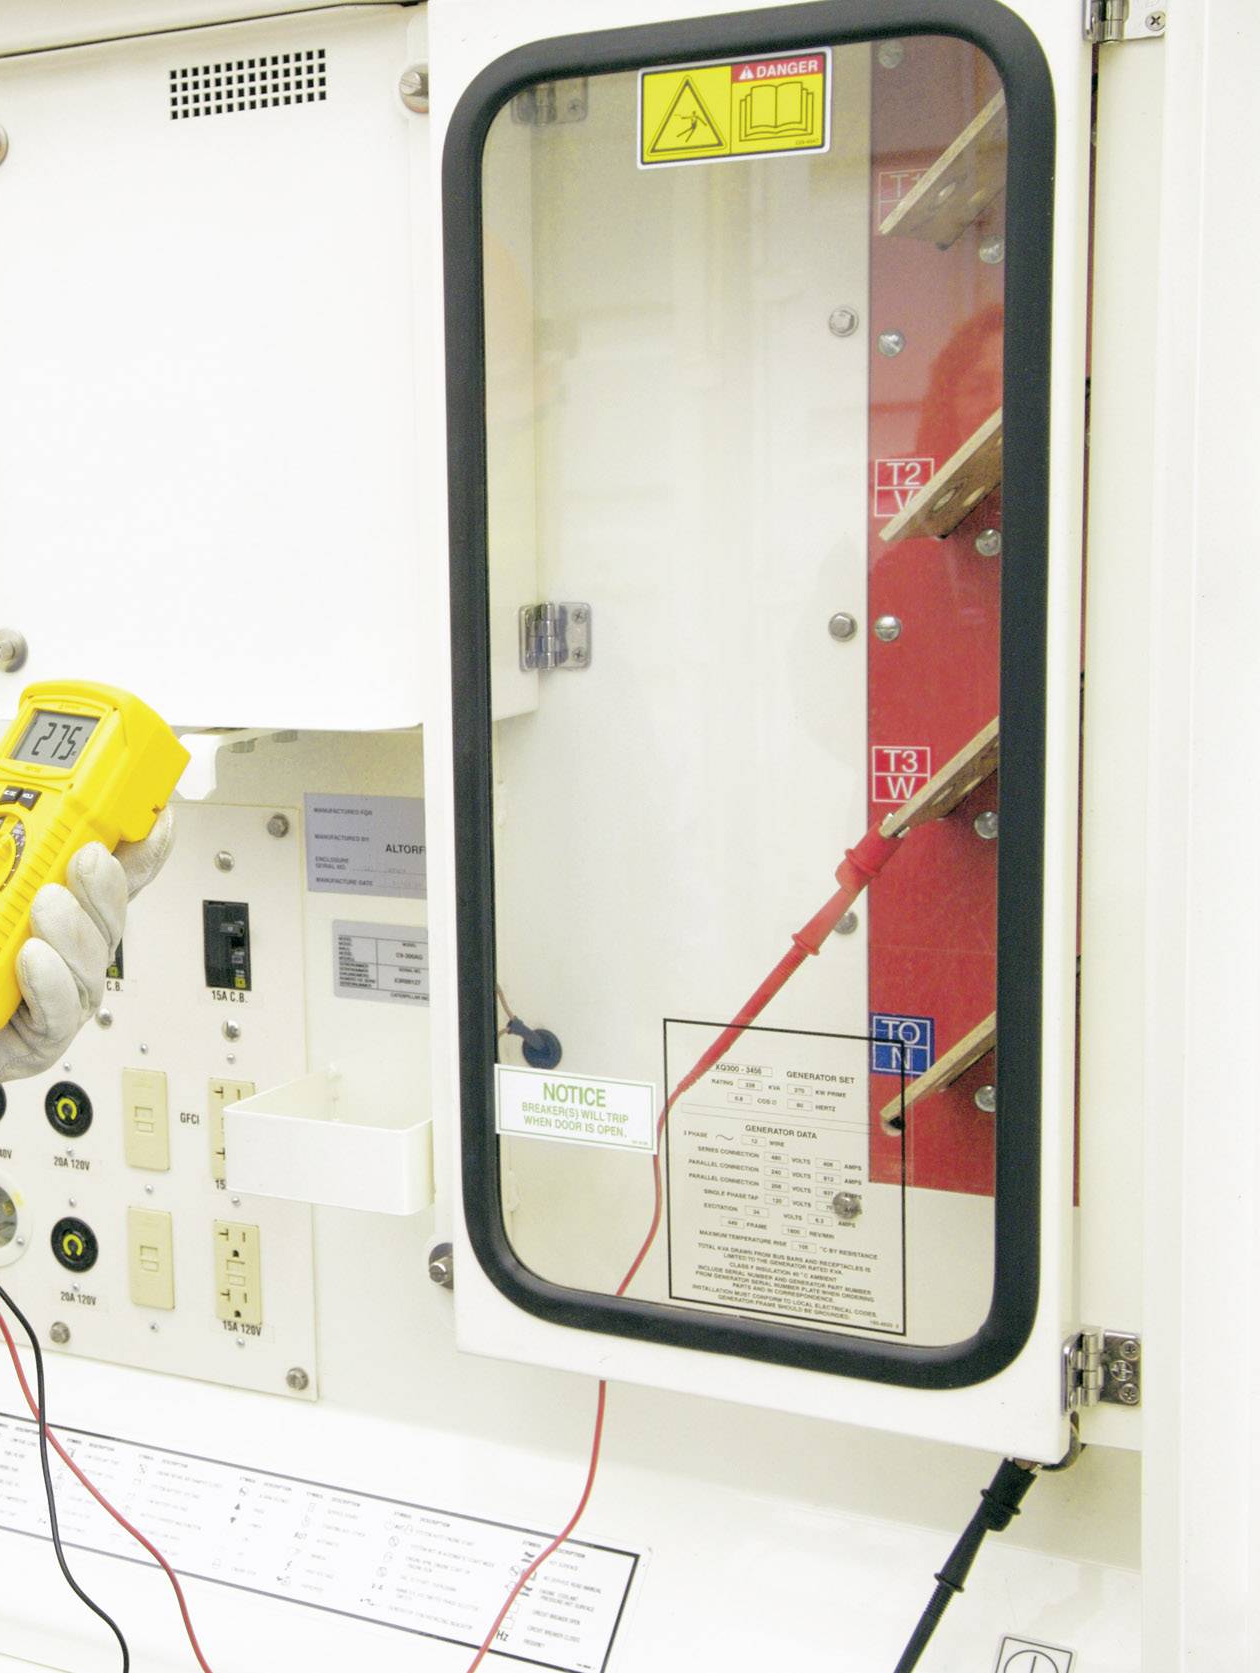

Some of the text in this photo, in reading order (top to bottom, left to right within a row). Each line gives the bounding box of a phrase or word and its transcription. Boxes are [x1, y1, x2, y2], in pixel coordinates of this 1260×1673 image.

[756, 60, 818, 78] DANGER
[886, 462, 921, 486] T2
[882, 749, 918, 773] T3
[886, 776, 916, 800] W
[314, 833, 360, 842] MANUFACTURED
[212, 990, 248, 1003] 15A C.B.
[786, 1070, 855, 1084] GENERATOR SET
[543, 1083, 606, 1107] NOTICE
[522, 1101, 629, 1123] BREAKER(S) WILL TRIP
[815, 1104, 836, 1112] HERTZ
[180, 1112, 200, 1124] GFCI
[523, 1115, 627, 1138] WHEN DOOR IS OPEN.
[688, 1130, 707, 1138] PHASE
[745, 1124, 817, 1140] GENERATOR DATA
[54, 1156, 90, 1171] 20A 120V
[720, 1149, 759, 1158] CONNECTION
[791, 1157, 810, 1165] VOLTS
[688, 1159, 718, 1168] PARALLEL
[719, 1162, 759, 1172] CONNECTION
[844, 1178, 862, 1186] AMPS
[688, 1173, 718, 1182] PARALLEL
[720, 1176, 759, 1186] CONNECTION
[726, 1191, 746, 1199] PHASE
[792, 1200, 811, 1208] VOLTS
[703, 1202, 738, 1211] EXCITATION
[783, 1213, 802, 1221] VOLTS
[838, 1220, 856, 1228] AMPS
[746, 1222, 767, 1230] FRAME
[728, 1234, 771, 1244] TEMPERATURE
[839, 1249, 878, 1260] RESISTANCE
[698, 1242, 715, 1250] TOTAL
[754, 1250, 771, 1258] FROM
[819, 1260, 863, 1272] RECEPTACLES
[60, 1291, 96, 1306] 20A 120V
[223, 1320, 262, 1337] 15A 120V
[496, 1630, 509, 1642] Hz
